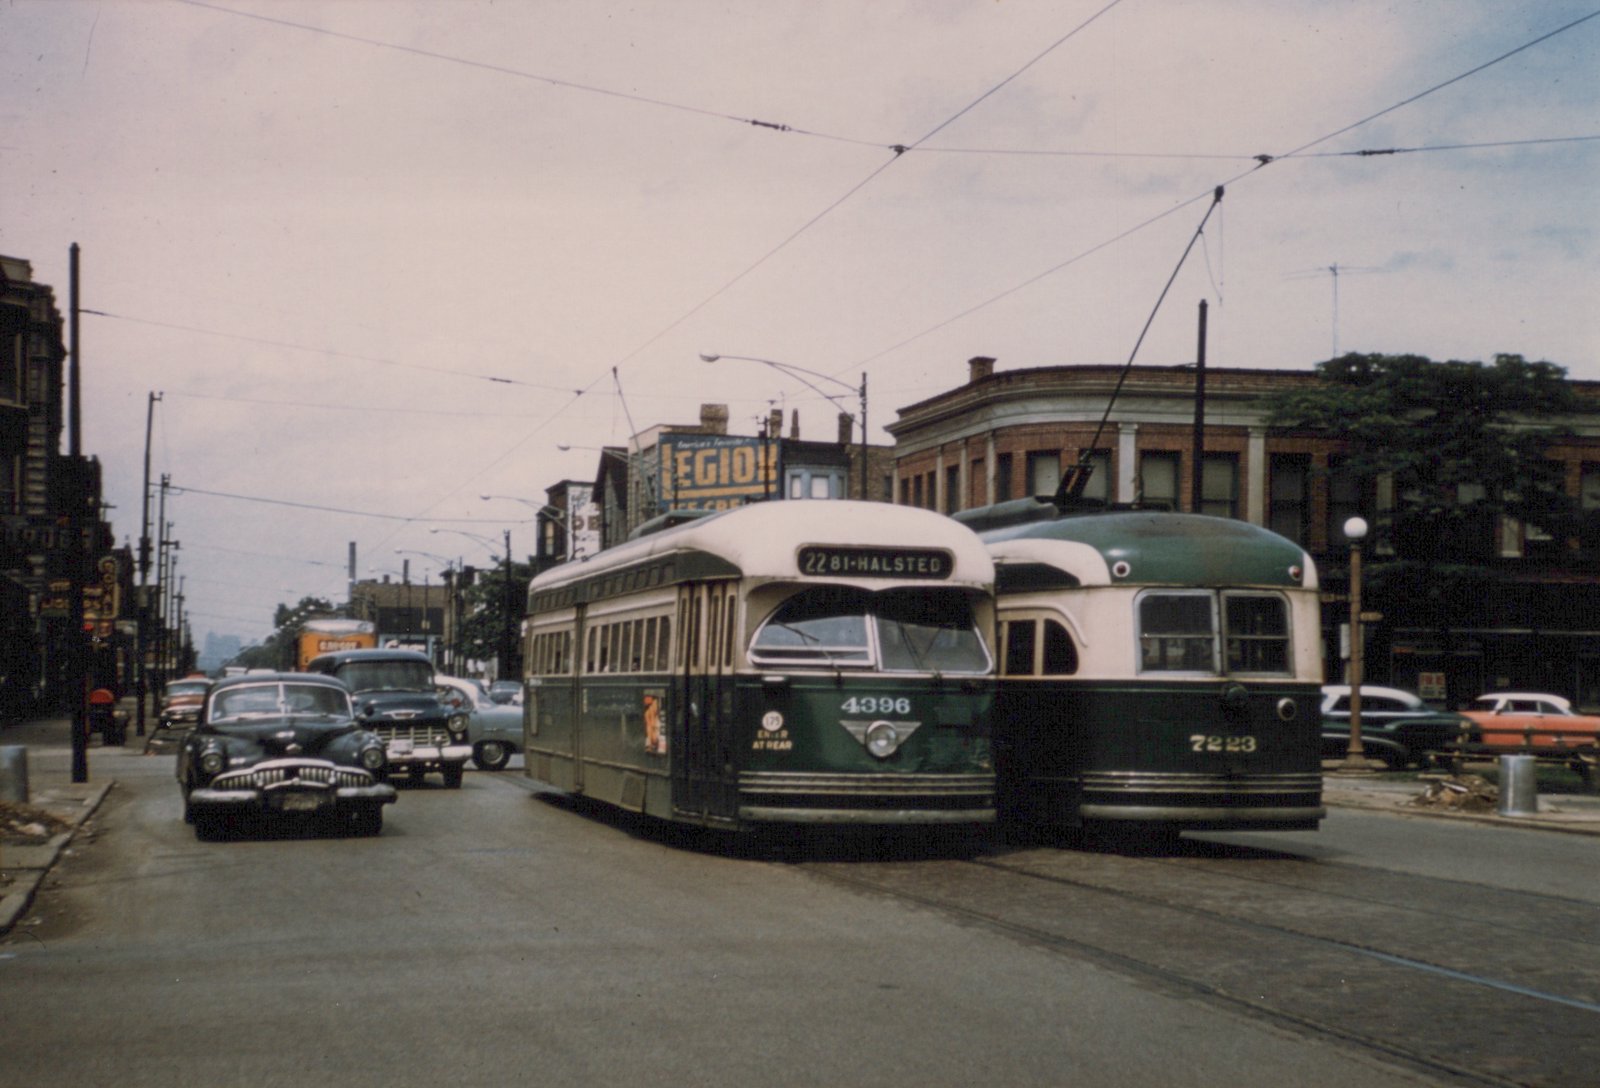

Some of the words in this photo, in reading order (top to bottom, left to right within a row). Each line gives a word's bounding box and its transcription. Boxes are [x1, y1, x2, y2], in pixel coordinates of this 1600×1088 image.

[661, 443, 777, 501] LEGION
[703, 498, 740, 512] CRE
[805, 552, 826, 573] 22
[840, 696, 911, 715] 4396
[757, 729, 789, 739] ENR
[752, 740, 765, 750] AT
[766, 740, 793, 750] REAR
[1190, 735, 1256, 752] 7223
